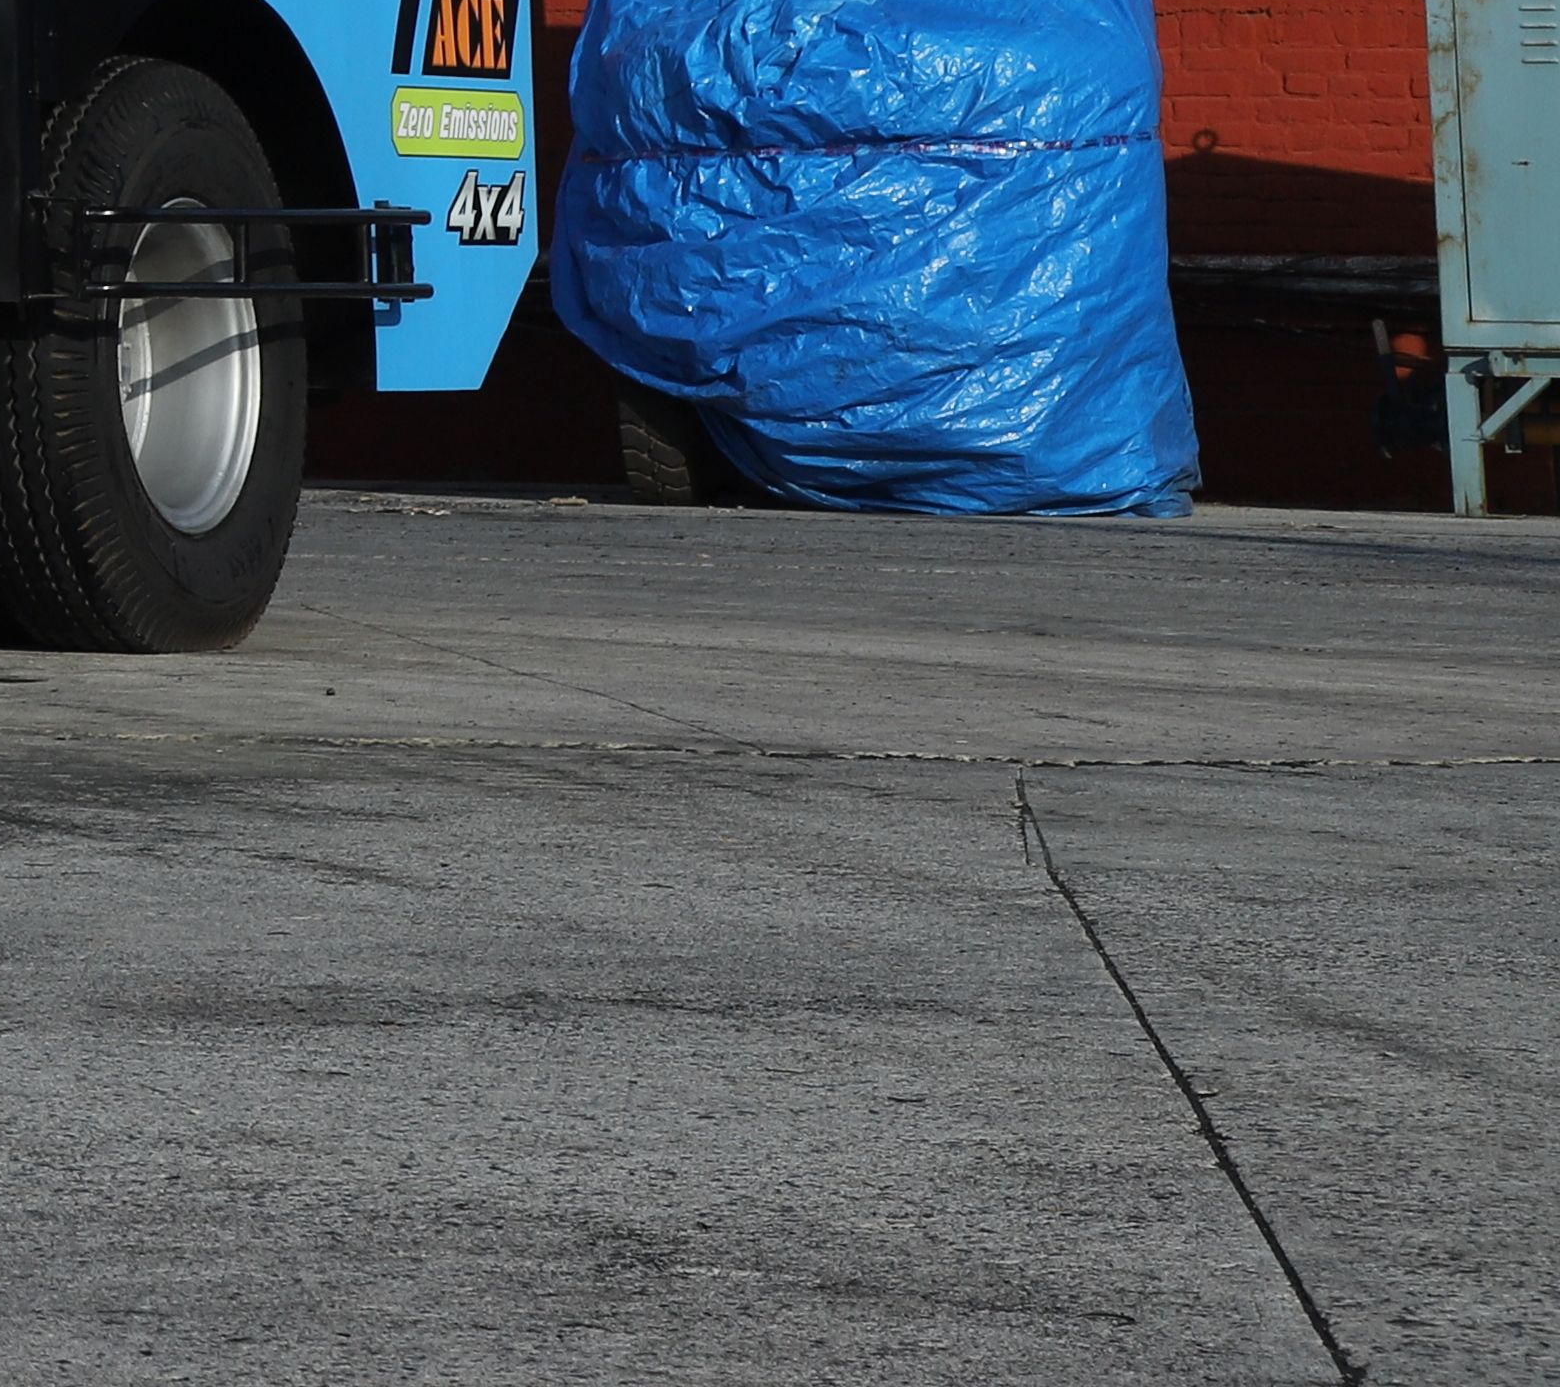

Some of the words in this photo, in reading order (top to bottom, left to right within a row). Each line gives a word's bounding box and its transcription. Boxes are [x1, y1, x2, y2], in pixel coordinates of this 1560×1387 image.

[397, 102, 435, 139] Zero
[439, 103, 519, 143] Emissions
[448, 170, 525, 244] 4x4
